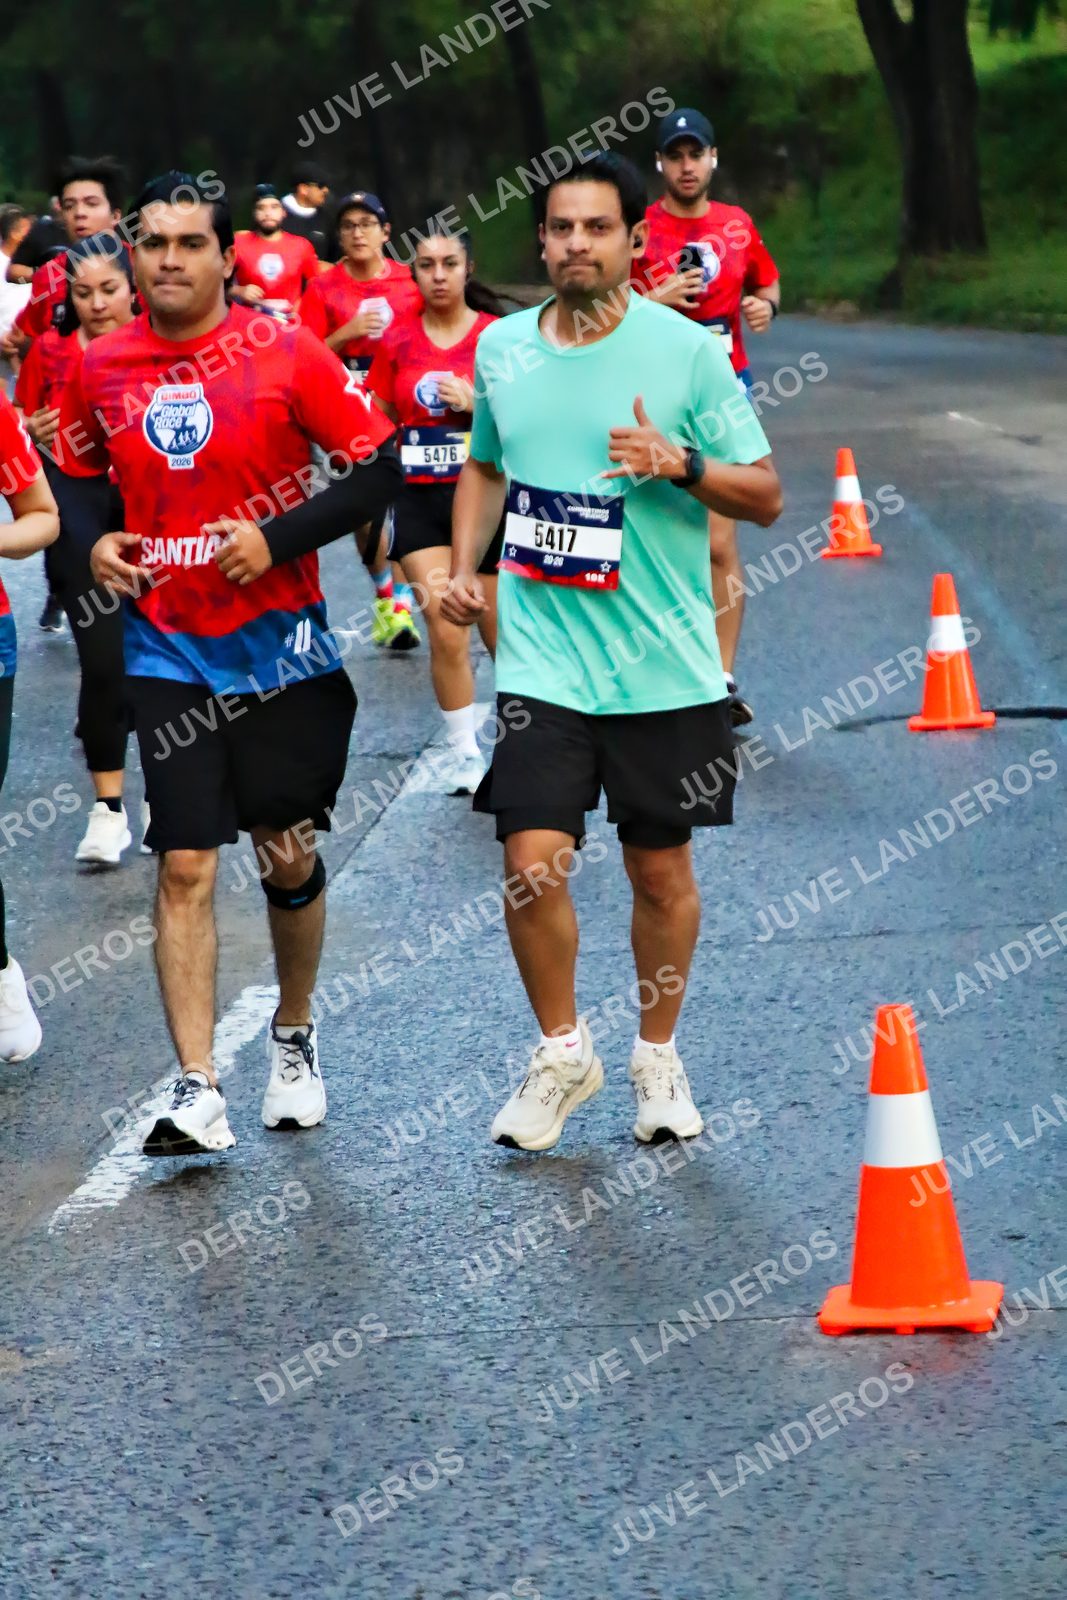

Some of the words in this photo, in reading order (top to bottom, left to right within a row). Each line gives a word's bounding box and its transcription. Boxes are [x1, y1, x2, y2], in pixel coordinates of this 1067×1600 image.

[160, 403, 196, 417] Global
[154, 416, 183, 429] Race
[424, 446, 457, 463] 5476
[171, 457, 192, 467] 2026
[535, 522, 577, 553] 5417
[585, 572, 606, 583] 10K
